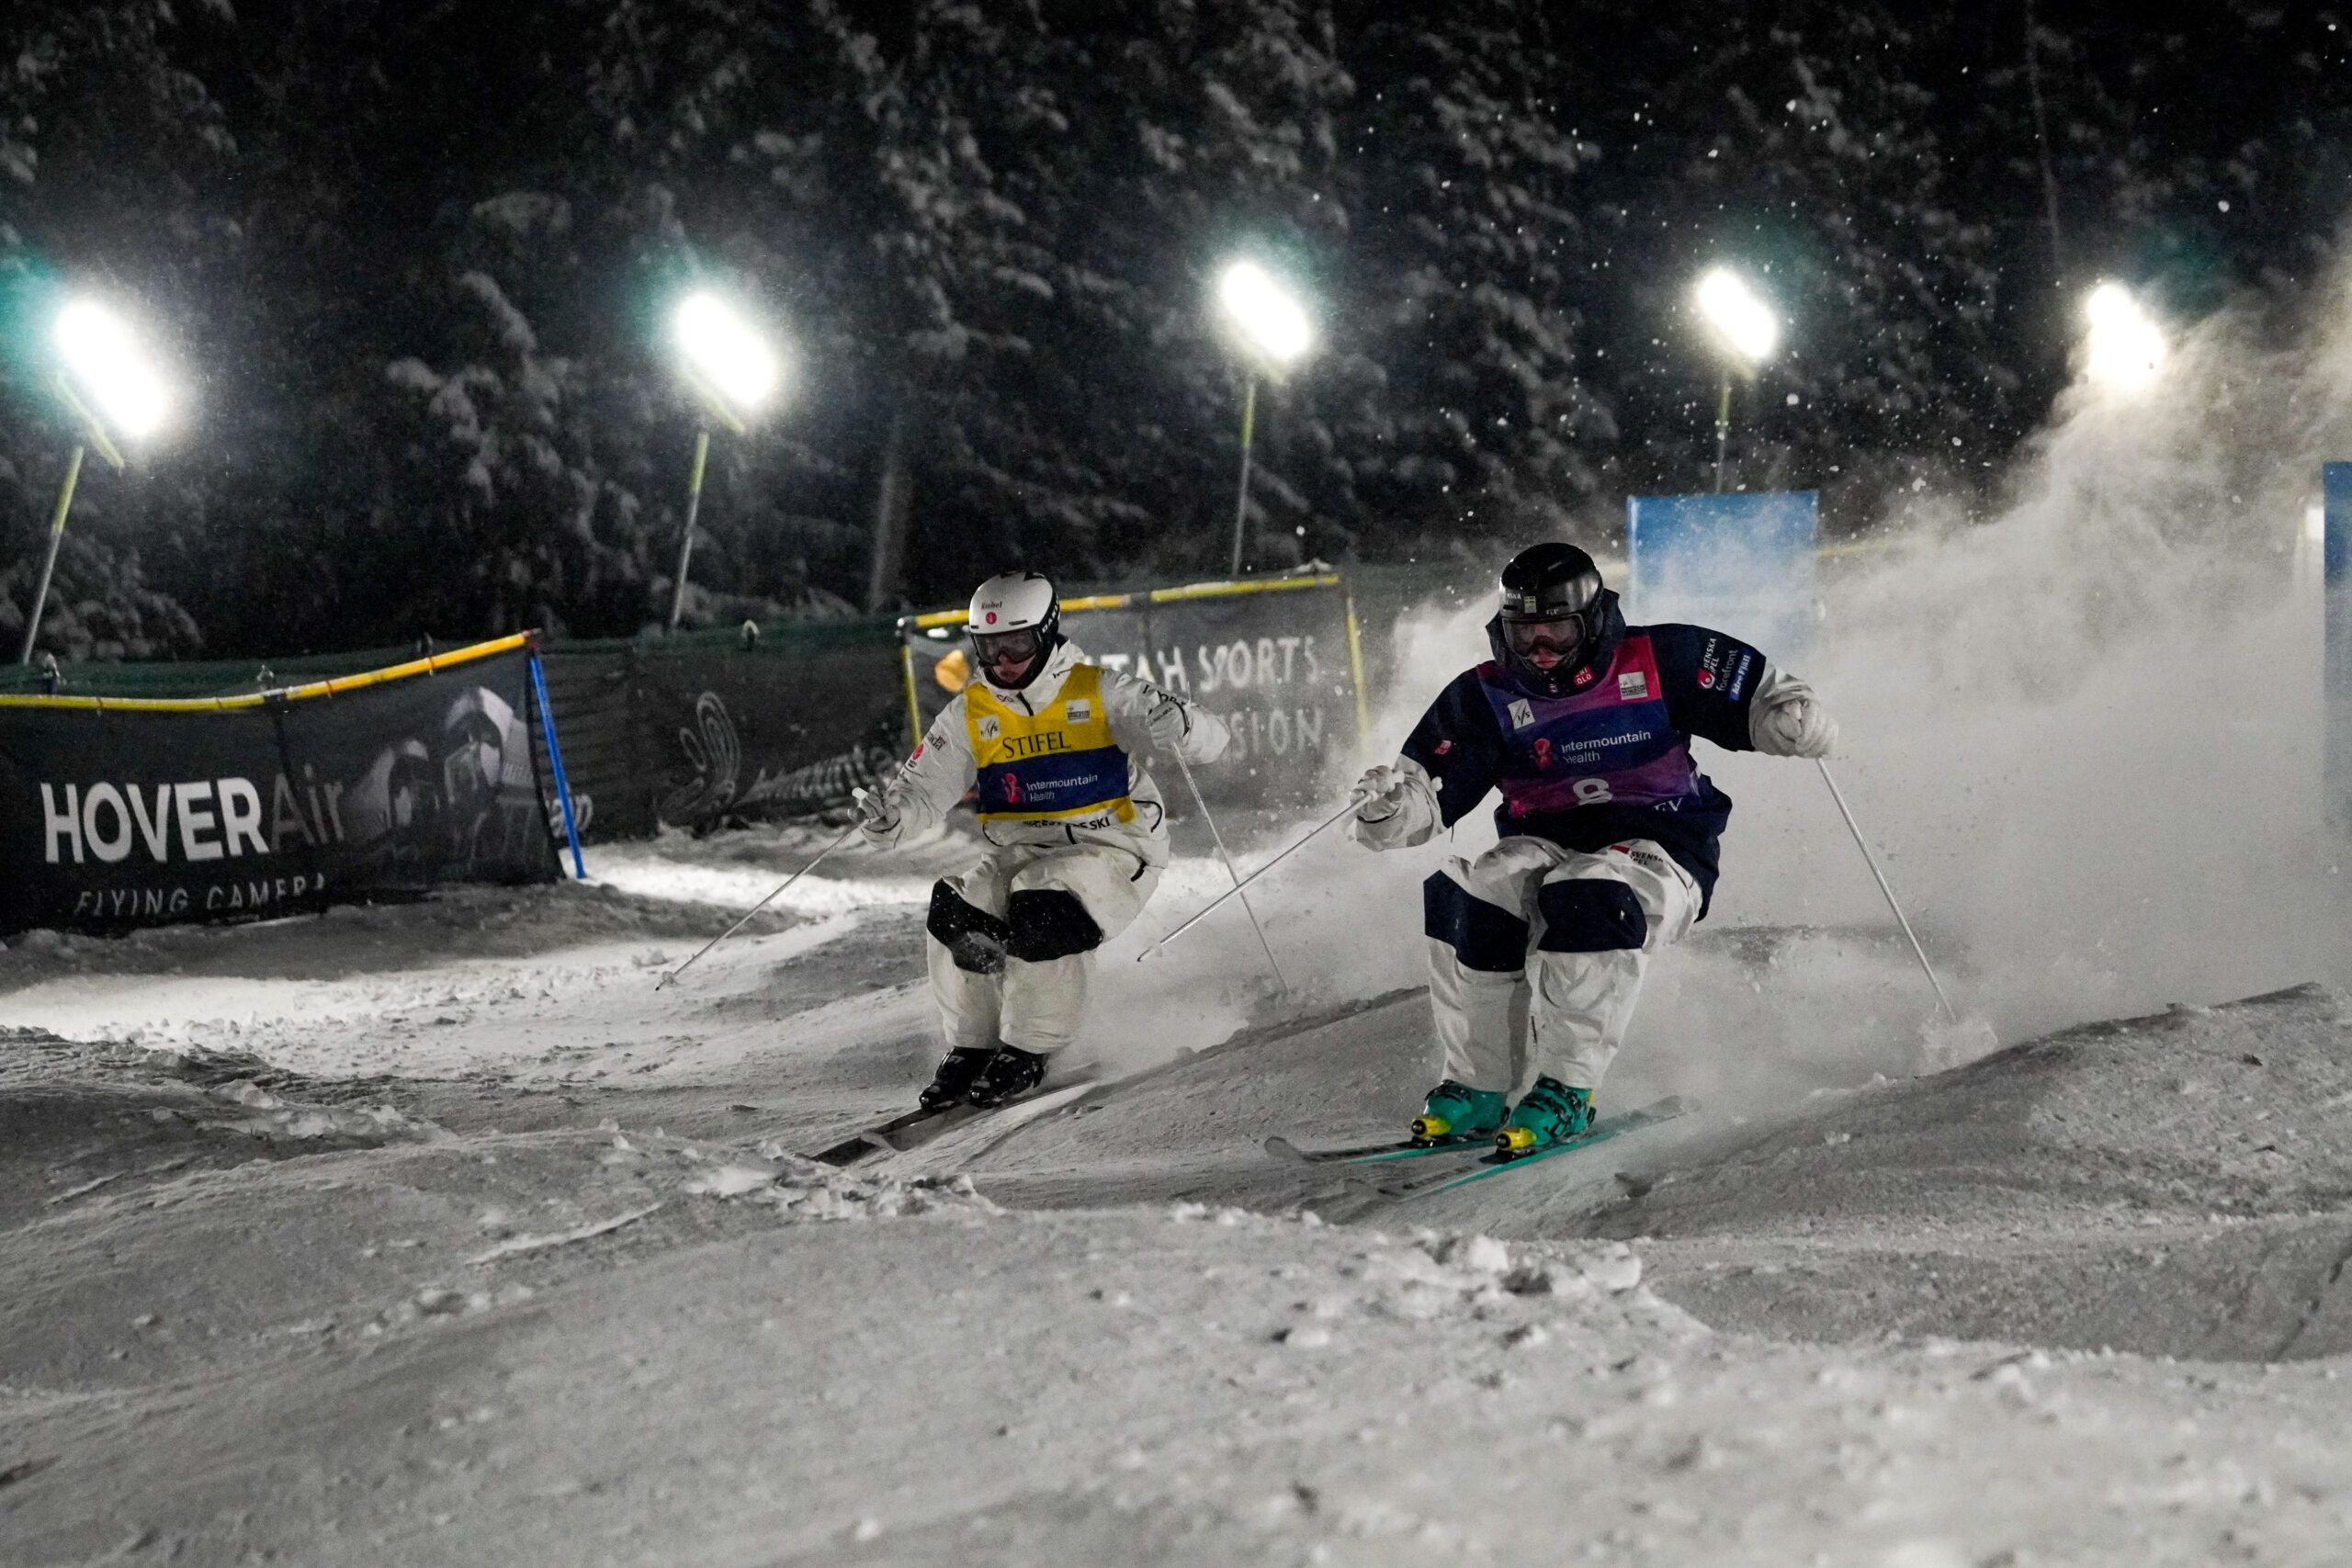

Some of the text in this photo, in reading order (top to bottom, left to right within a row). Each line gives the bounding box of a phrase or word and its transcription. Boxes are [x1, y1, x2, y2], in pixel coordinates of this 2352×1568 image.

[1198, 635, 1317, 692] SPORTS
[1577, 673, 1592, 684] QLO
[1002, 731, 1072, 759] STIFEL
[1561, 730, 1652, 754] Intermountain
[1563, 750, 1600, 765] Health
[1025, 773, 1099, 792] Intermountain
[1030, 791, 1055, 803] Health
[1089, 817, 1111, 830] SKI
